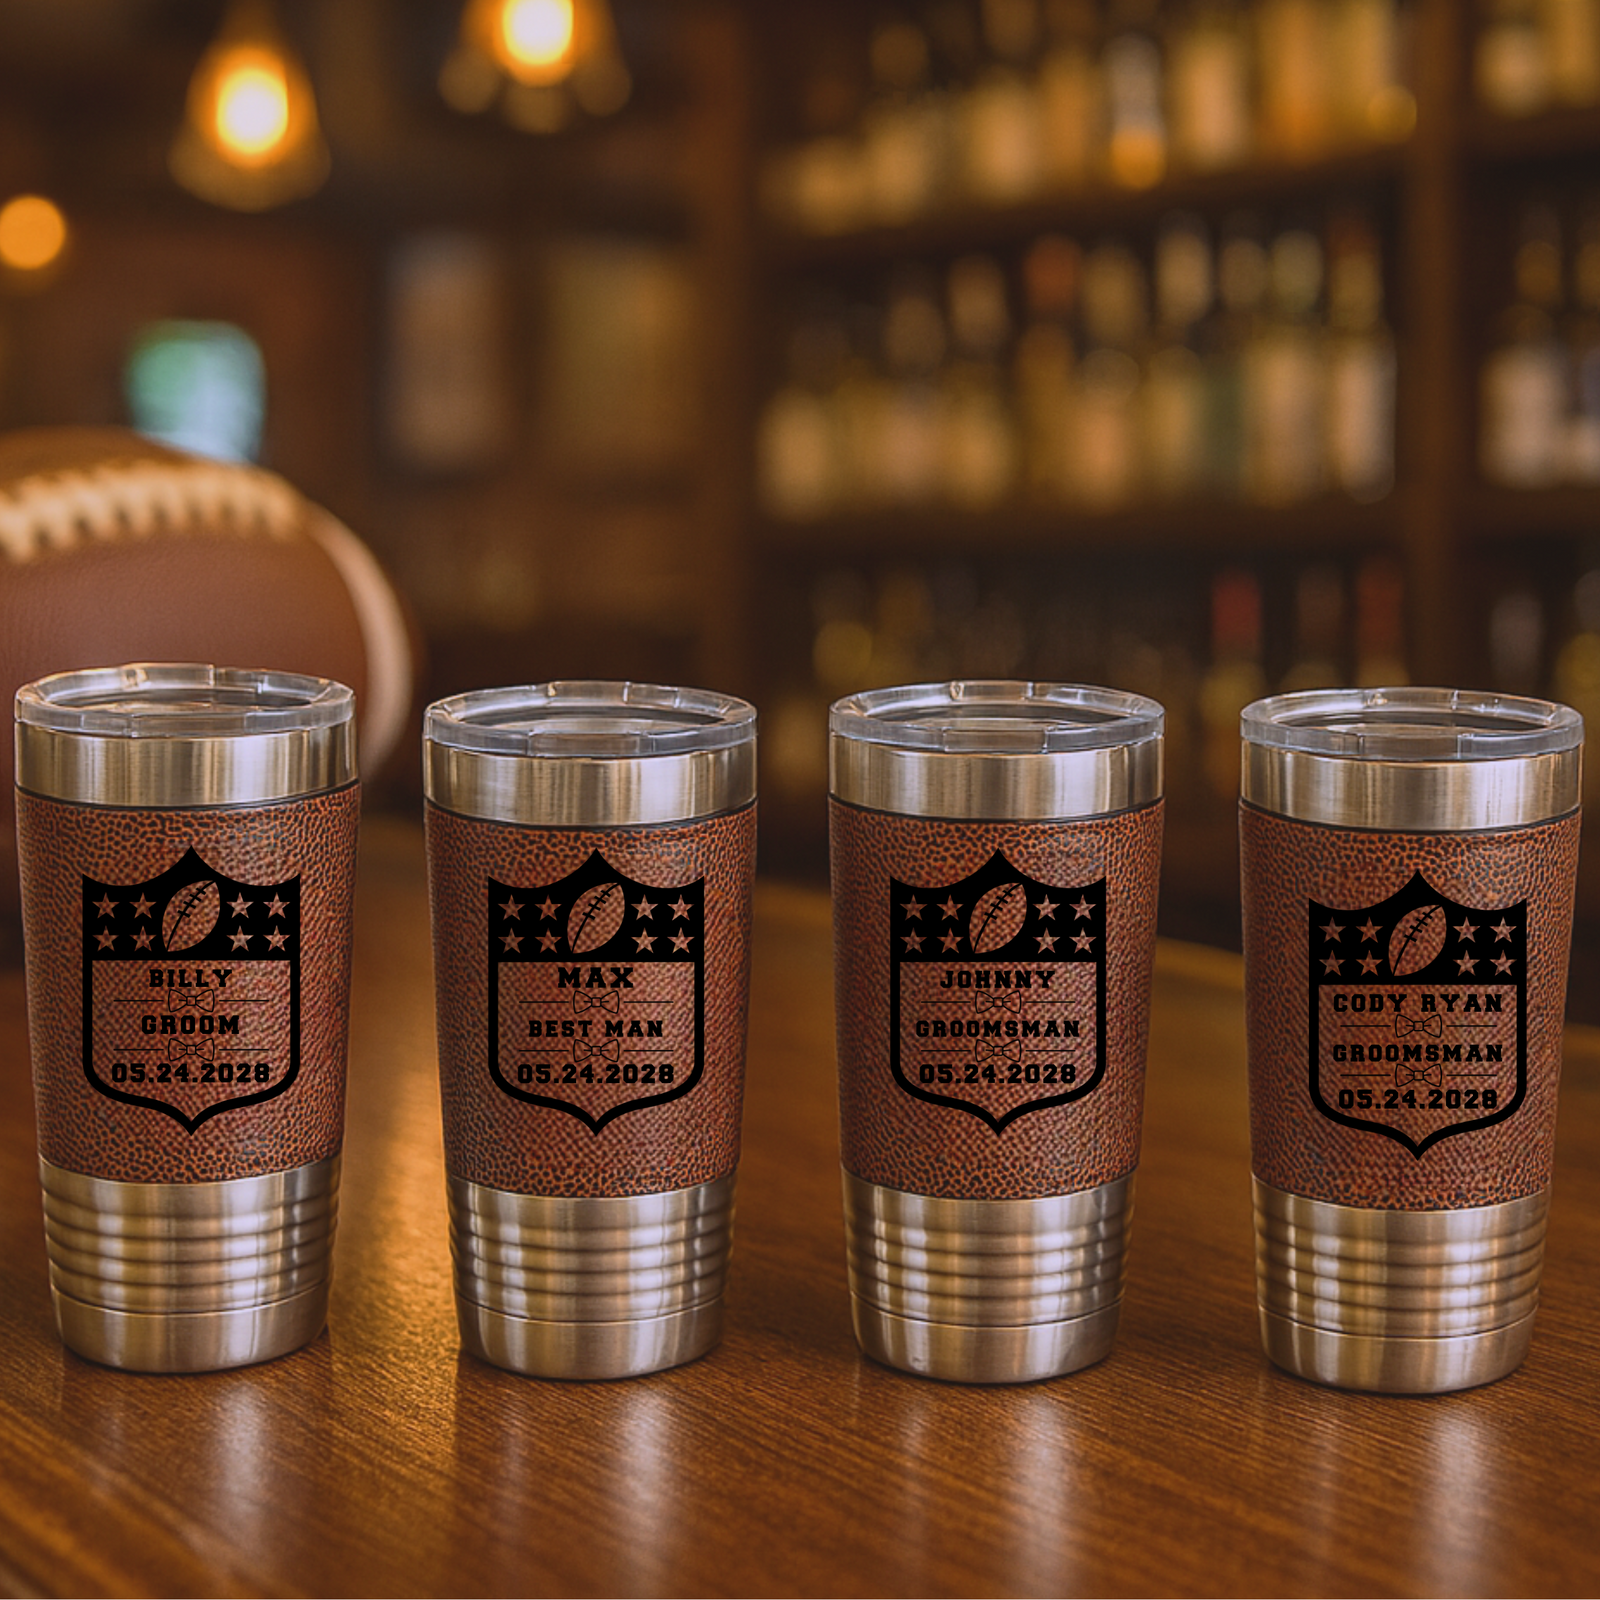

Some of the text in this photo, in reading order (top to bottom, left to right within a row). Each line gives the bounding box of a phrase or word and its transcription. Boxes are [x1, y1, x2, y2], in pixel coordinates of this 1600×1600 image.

[150, 969, 232, 987] BILLY
[558, 967, 634, 988] MAX
[940, 971, 1055, 989] JOHNNY
[1334, 994, 1502, 1012] CODY RYAN
[142, 1015, 239, 1034] GROOM
[529, 1020, 663, 1037] BEST MAN
[916, 1020, 1079, 1037] GROOMSMAN
[1333, 1044, 1502, 1062] GROOMSMAN
[112, 1064, 269, 1083] 05.24.2028
[518, 1064, 674, 1083] 05.24.2028
[920, 1064, 1075, 1083] 05.24.2028
[1339, 1090, 1498, 1109] 05.24.2028
